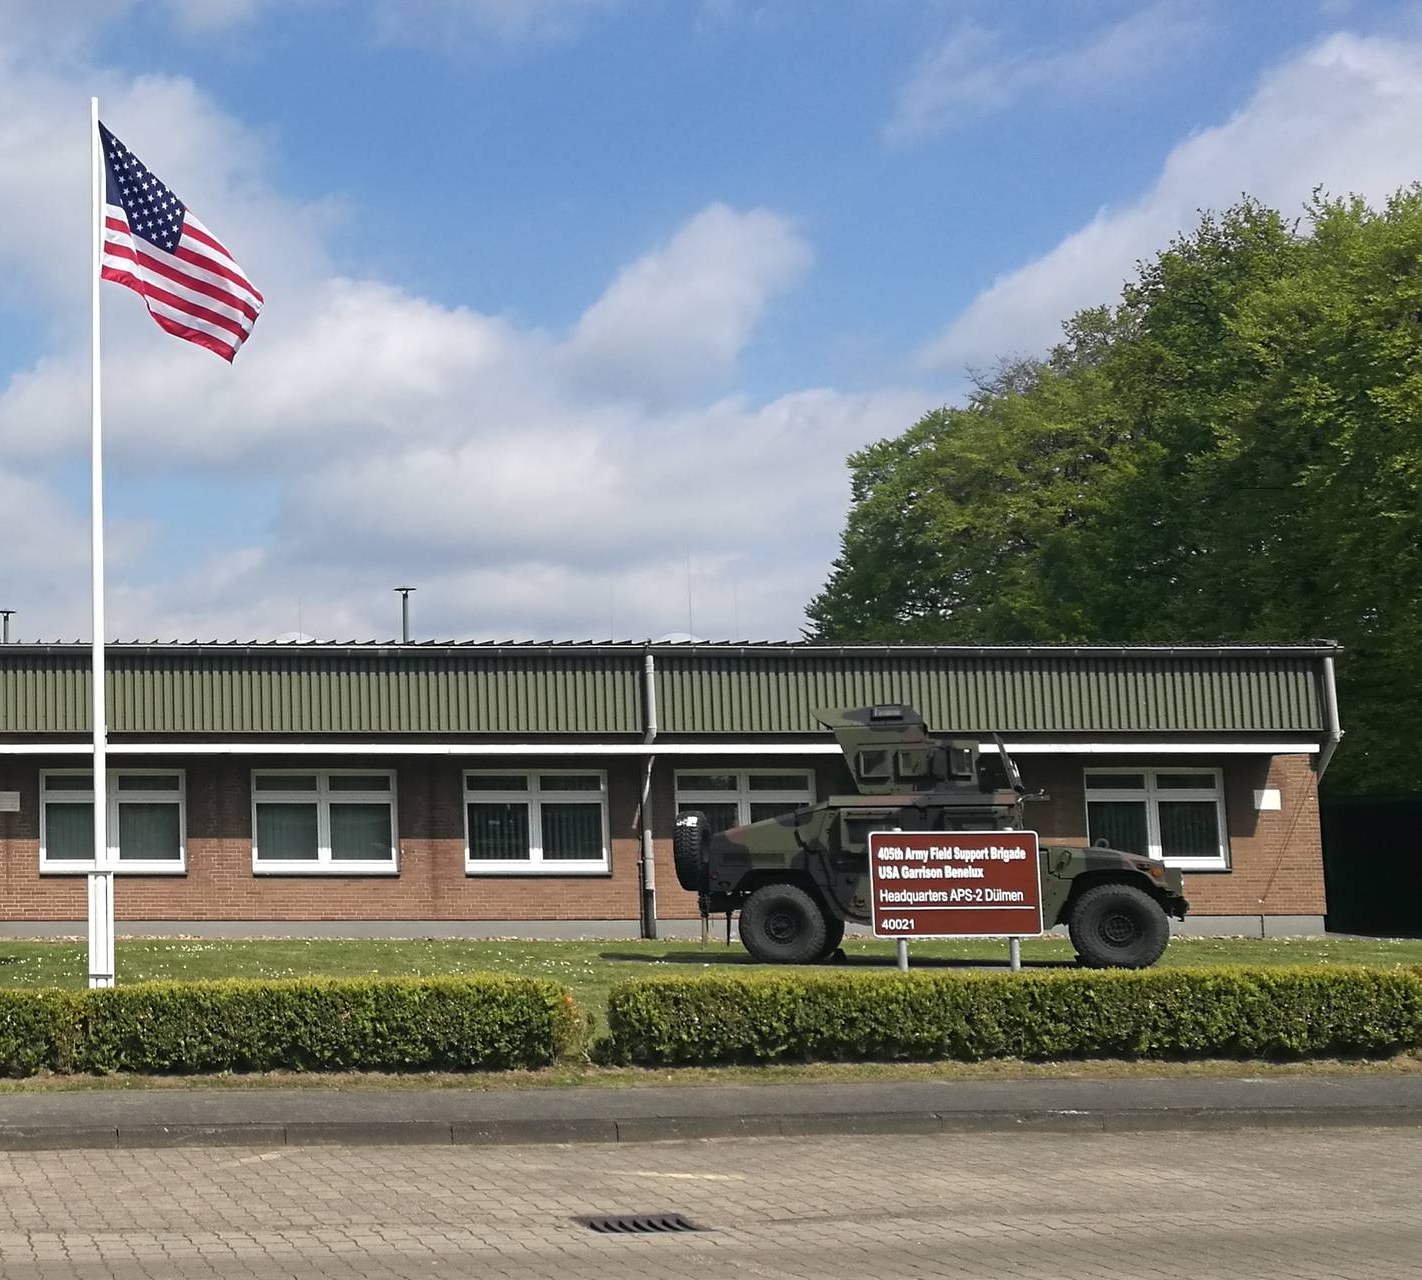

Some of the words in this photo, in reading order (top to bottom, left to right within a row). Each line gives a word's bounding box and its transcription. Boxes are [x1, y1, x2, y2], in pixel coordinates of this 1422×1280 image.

[878, 847, 903, 860] 405th
[905, 847, 928, 863] Army
[930, 847, 952, 860] Field
[953, 847, 989, 862] Support
[990, 847, 1026, 862] Brigade
[878, 866, 900, 879] USA
[901, 866, 943, 879] Garrison
[944, 866, 984, 879] Benelux
[880, 889, 948, 904] Headquarters
[950, 889, 983, 902] APS-2
[985, 889, 1024, 901] Dülmen
[882, 919, 915, 930] 40021
